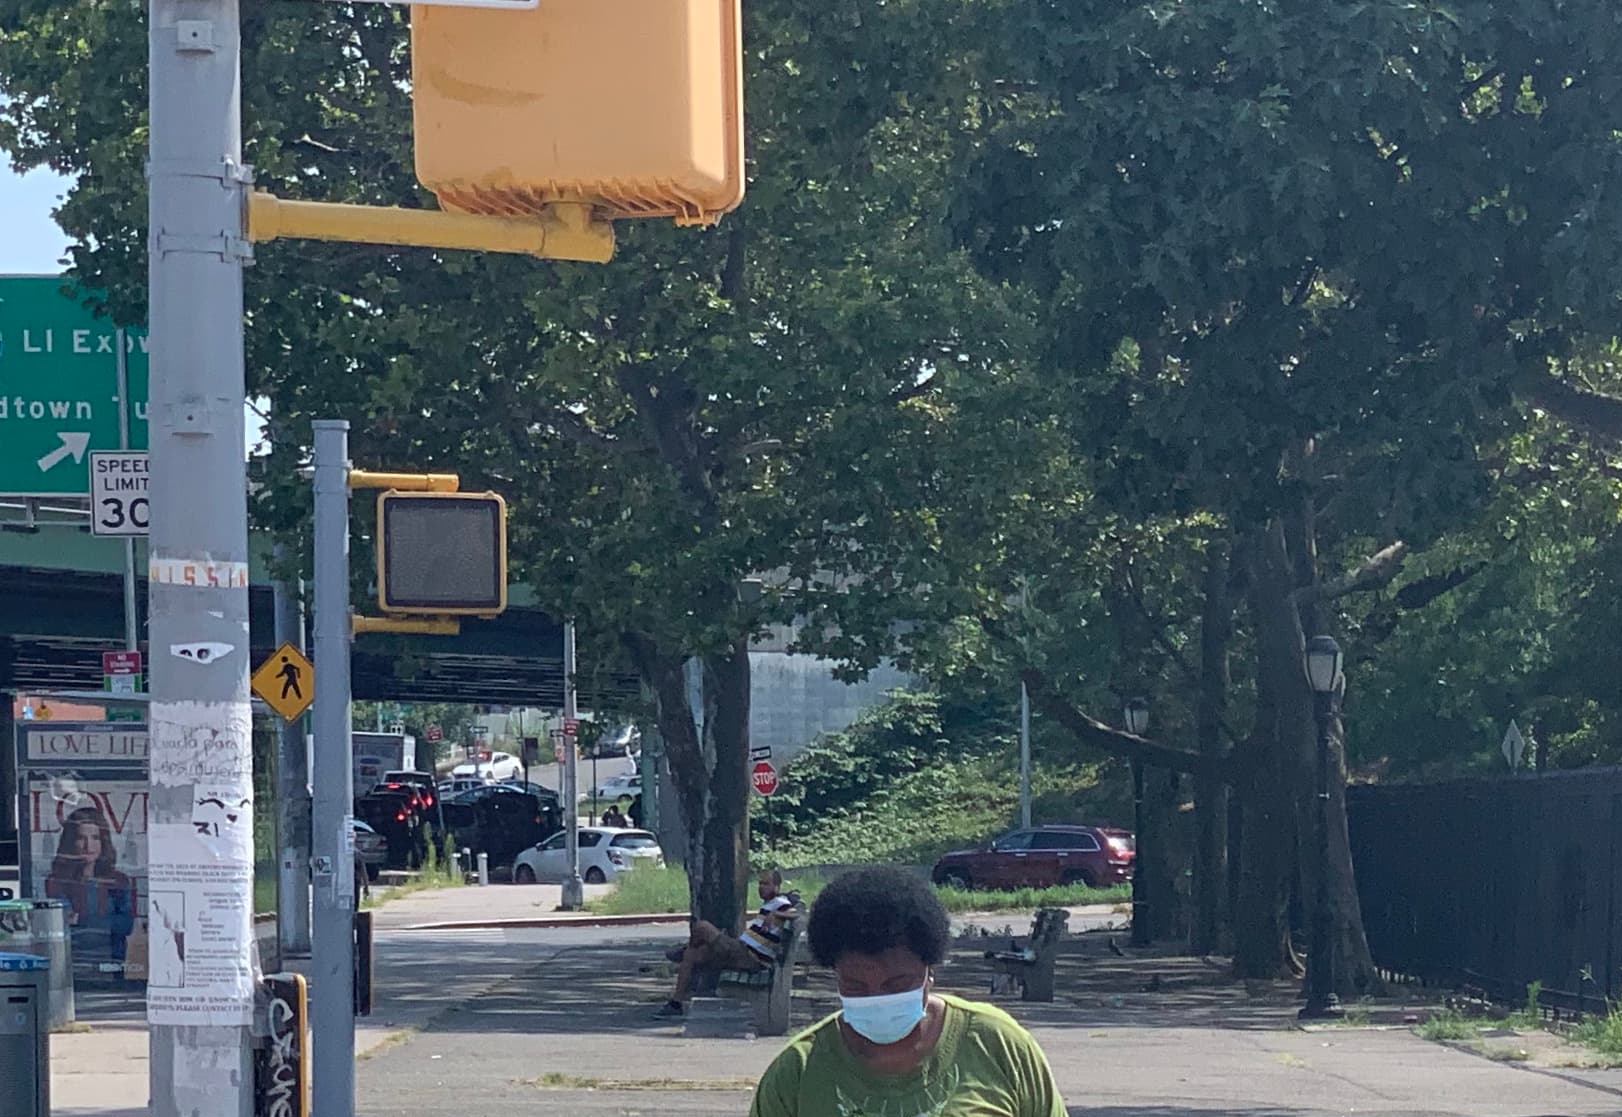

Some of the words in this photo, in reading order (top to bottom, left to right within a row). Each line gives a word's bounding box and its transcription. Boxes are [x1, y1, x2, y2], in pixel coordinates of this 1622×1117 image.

[23, 329, 53, 353] LI
[104, 477, 149, 491] LIMIT
[101, 498, 149, 528] 30
[39, 734, 99, 755] LOVE
[753, 771, 776, 786] STOP
